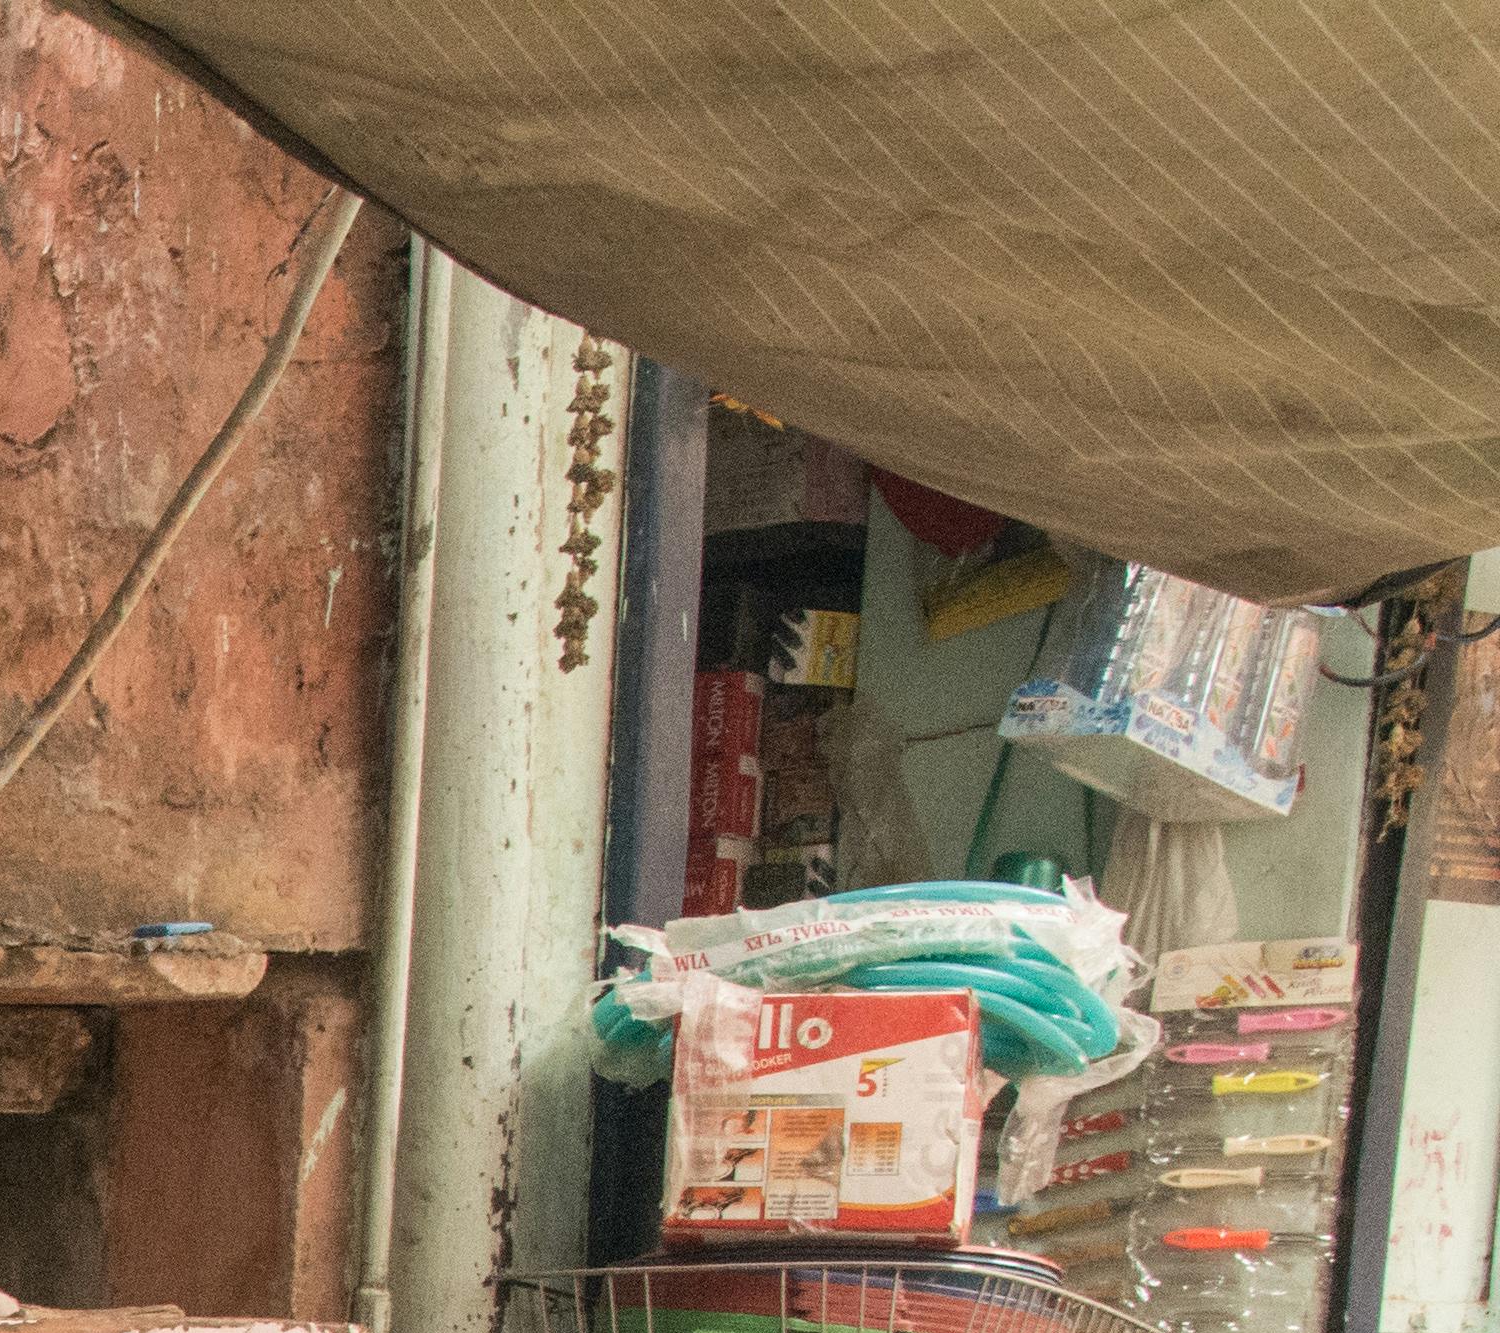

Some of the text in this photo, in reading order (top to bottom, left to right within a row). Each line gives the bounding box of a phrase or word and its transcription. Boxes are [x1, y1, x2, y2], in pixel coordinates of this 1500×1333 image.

[793, 920, 851, 943] VIMAL
[753, 1053, 792, 1071] OOKER
[857, 1072, 877, 1098] 5
